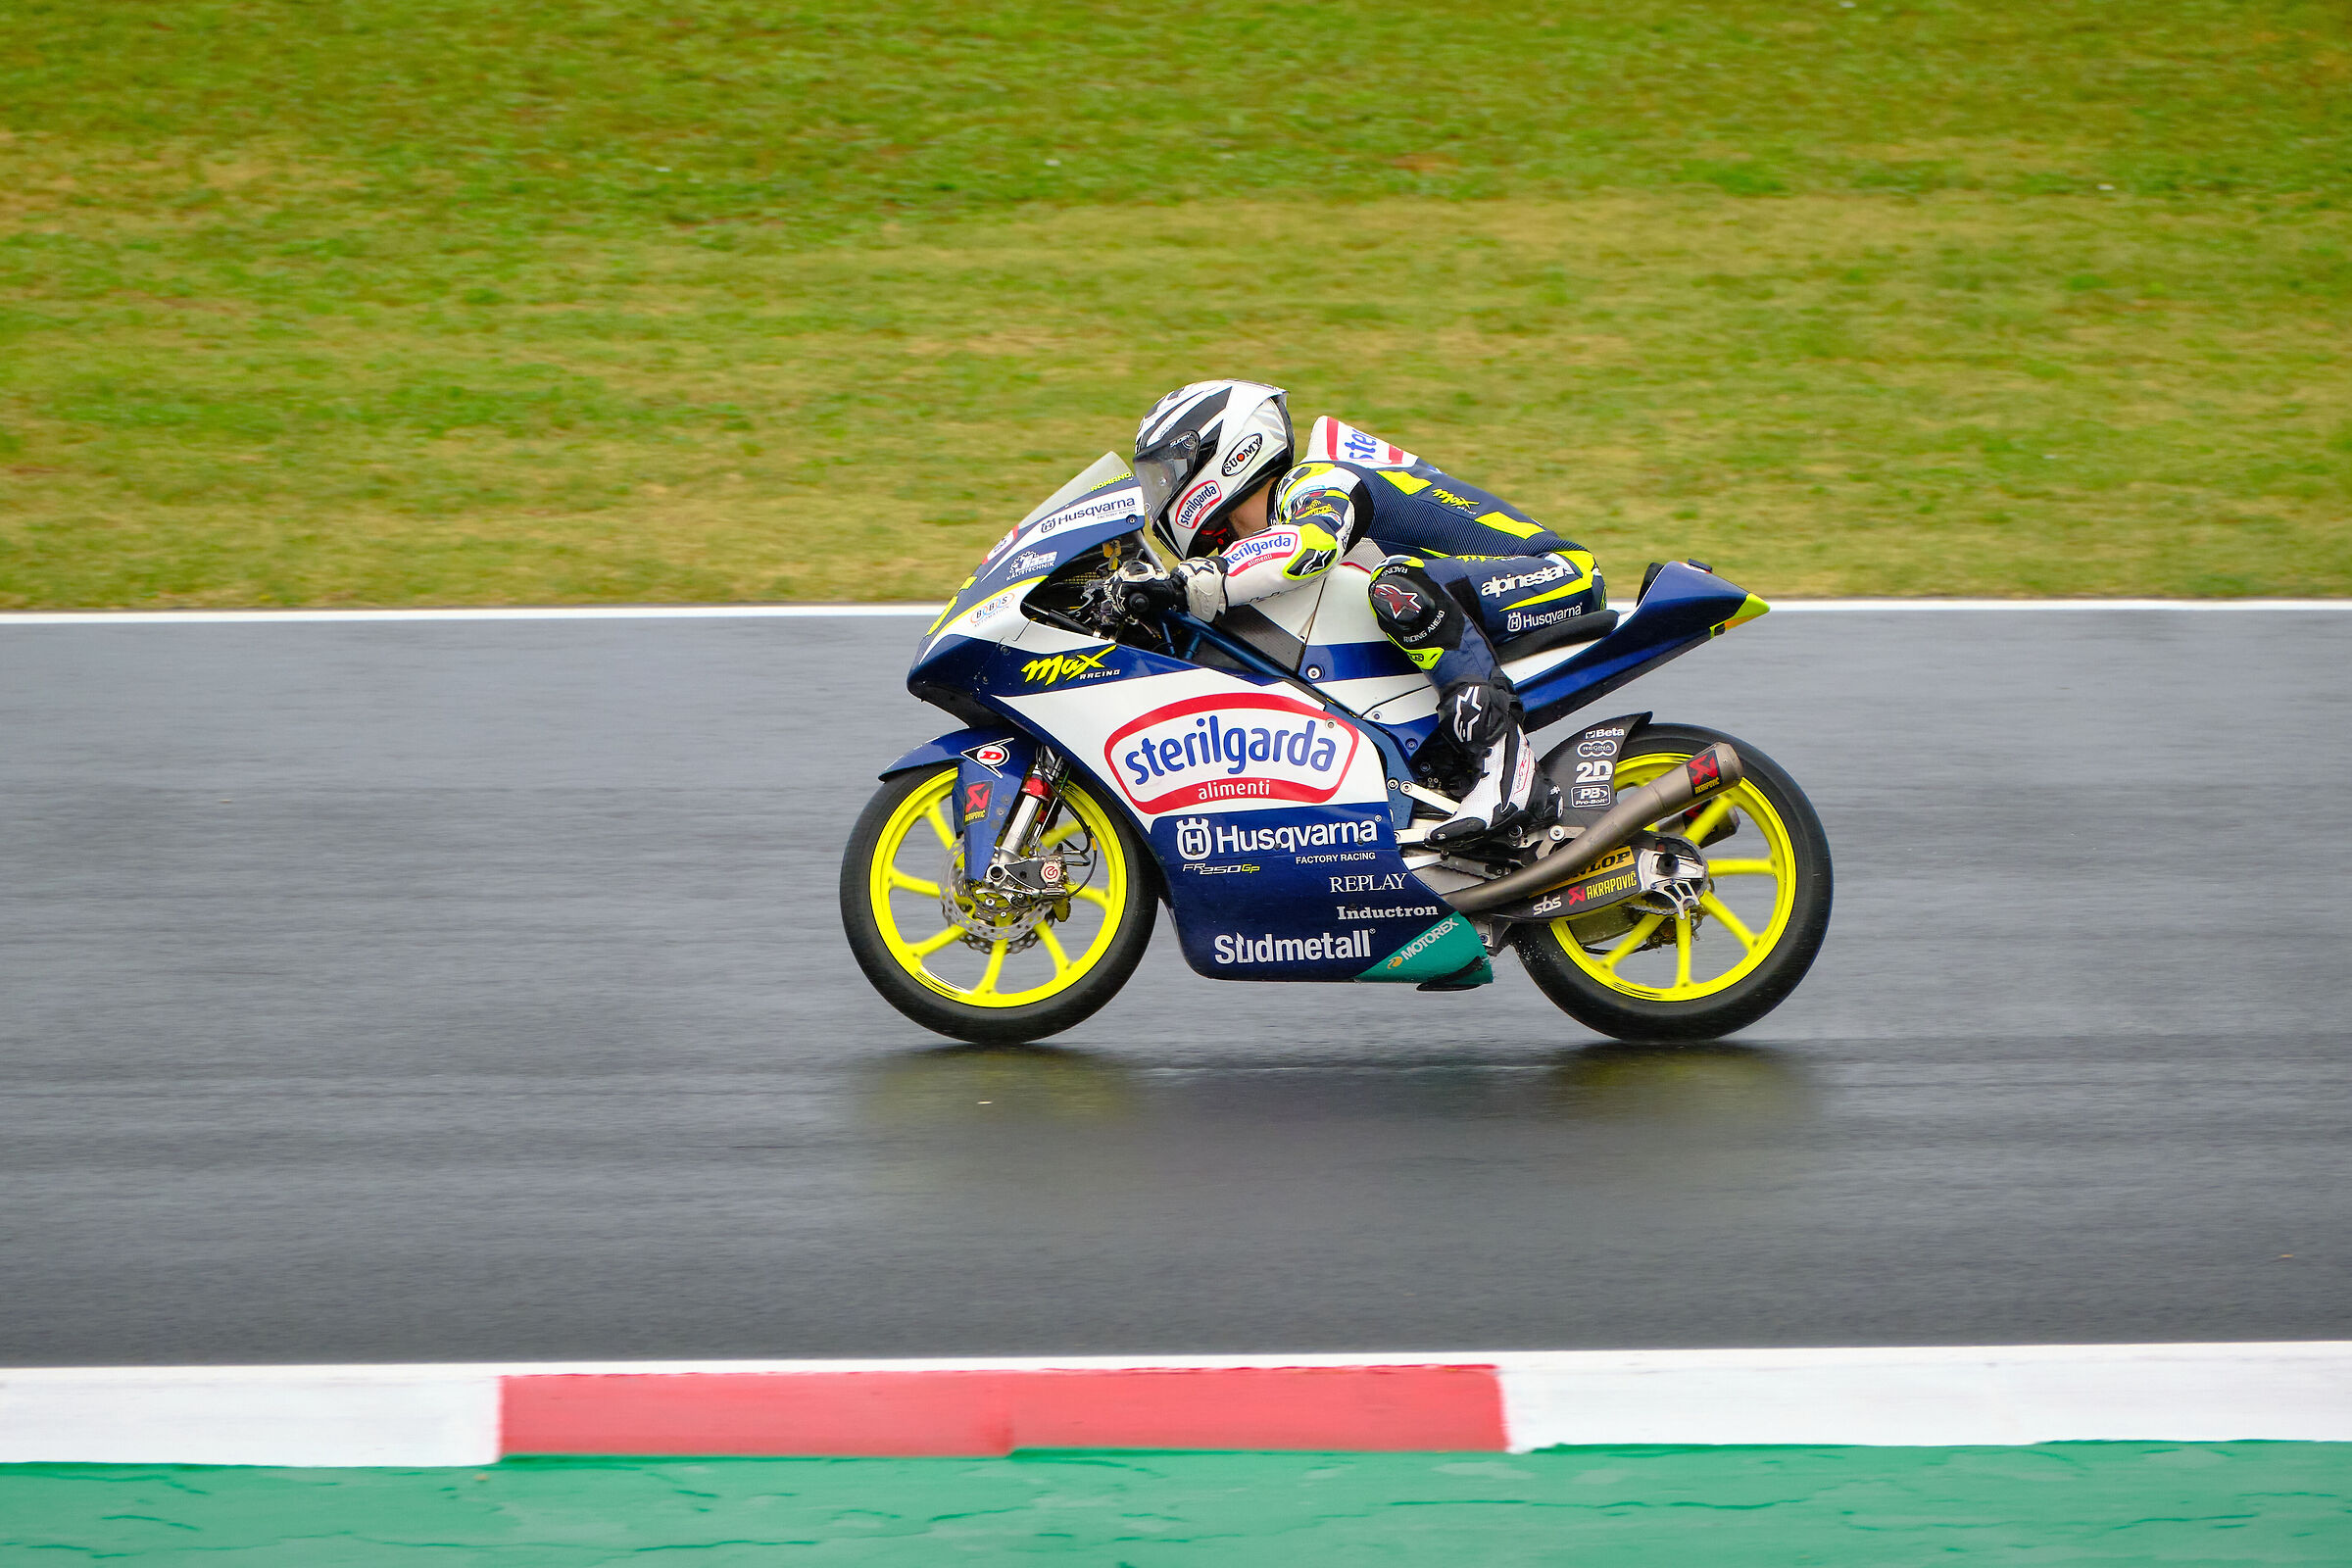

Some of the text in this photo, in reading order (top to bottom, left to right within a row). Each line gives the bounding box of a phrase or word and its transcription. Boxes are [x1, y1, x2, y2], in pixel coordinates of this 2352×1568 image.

[1223, 437, 1261, 472] SUOMY
[1058, 497, 1136, 525] Husqvarna
[1180, 483, 1217, 525] sterilgarda
[1226, 535, 1292, 565] terilgarda
[1247, 553, 1273, 567] alimenti
[1381, 565, 1408, 578] RACING
[1403, 610, 1446, 644] RACING AHEAD
[1522, 605, 1582, 629] Husqvarna
[1079, 668, 1121, 680] RACING
[1595, 728, 1625, 738] Beta
[1125, 714, 1337, 786] sterilgarda
[1575, 760, 1614, 784] 2D
[1198, 779, 1271, 801] alimenti
[1216, 819, 1378, 854] Husqvarna
[1296, 852, 1376, 864] FACTORY RACING
[1573, 851, 1631, 878] LOP
[1329, 872, 1408, 894] REPLAY
[1336, 905, 1439, 920] Inductron
[1533, 895, 1562, 916] sbs
[1400, 917, 1459, 960] MOTOREX
